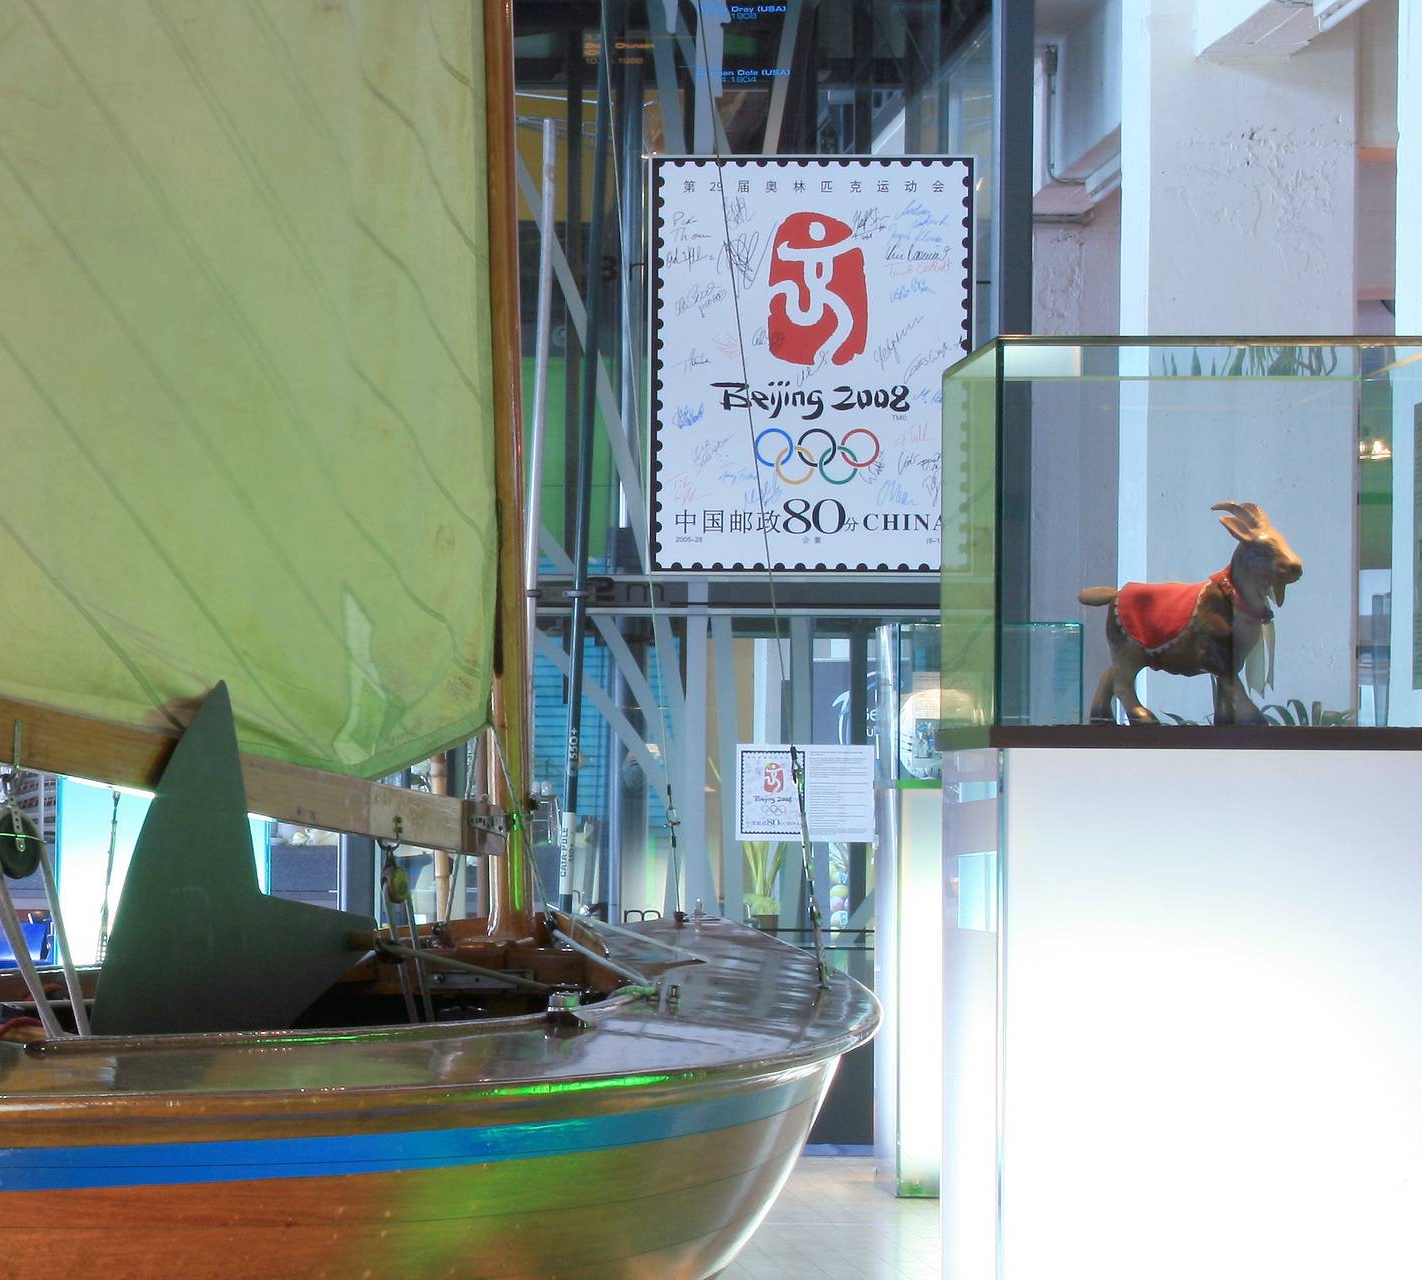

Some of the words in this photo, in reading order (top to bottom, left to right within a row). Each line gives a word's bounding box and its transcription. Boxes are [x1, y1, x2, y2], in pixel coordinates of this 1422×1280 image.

[709, 380, 824, 420] Beijing
[830, 385, 911, 412] 2008
[675, 509, 781, 534] 中国邮政
[782, 498, 846, 535] 80
[844, 516, 859, 532] 分
[569, 727, 579, 760] 550+
